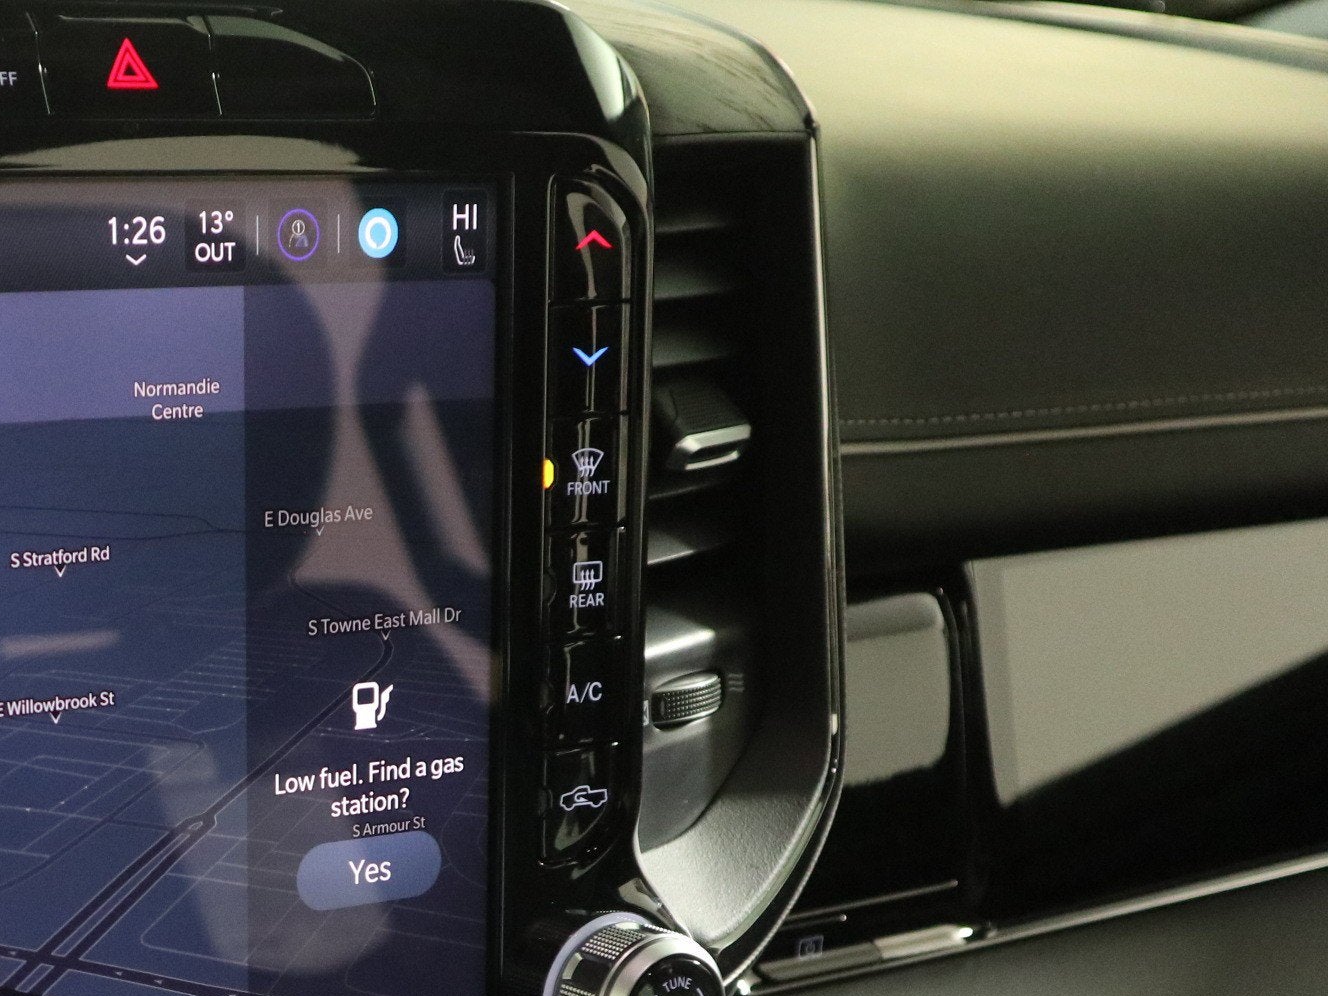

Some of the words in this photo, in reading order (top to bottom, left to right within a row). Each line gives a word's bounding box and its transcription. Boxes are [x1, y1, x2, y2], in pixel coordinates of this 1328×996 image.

[198, 210, 234, 235] 13°
[452, 203, 478, 231] HI
[108, 216, 166, 245] 1:26
[195, 242, 236, 263] OUT
[133, 378, 221, 398] Normandie
[151, 402, 204, 421] Centre
[567, 480, 610, 496] FRONT
[264, 510, 274, 527] E
[278, 507, 342, 527] Douglas
[344, 505, 373, 521] Ave
[10, 553, 20, 568] S
[23, 548, 87, 567] Stratford
[90, 546, 110, 562] Rd
[569, 592, 605, 608] REAR
[308, 619, 318, 636] S
[321, 615, 371, 634] Towne
[374, 612, 406, 630] East
[409, 608, 440, 626] Mall
[444, 607, 462, 623] Dr
[7, 693, 98, 716] Willowbrook
[100, 691, 115, 707] St
[566, 681, 603, 704] A/C
[274, 773, 316, 796] Low
[319, 764, 364, 789] fuel.
[368, 757, 412, 784] Find
[415, 761, 428, 778] a
[430, 756, 465, 780] gas
[330, 788, 411, 818] station?
[352, 824, 361, 838] S
[362, 819, 411, 836] Armour
[413, 816, 426, 829] St
[348, 860, 392, 885] Yes
[662, 976, 693, 993] TUNE
